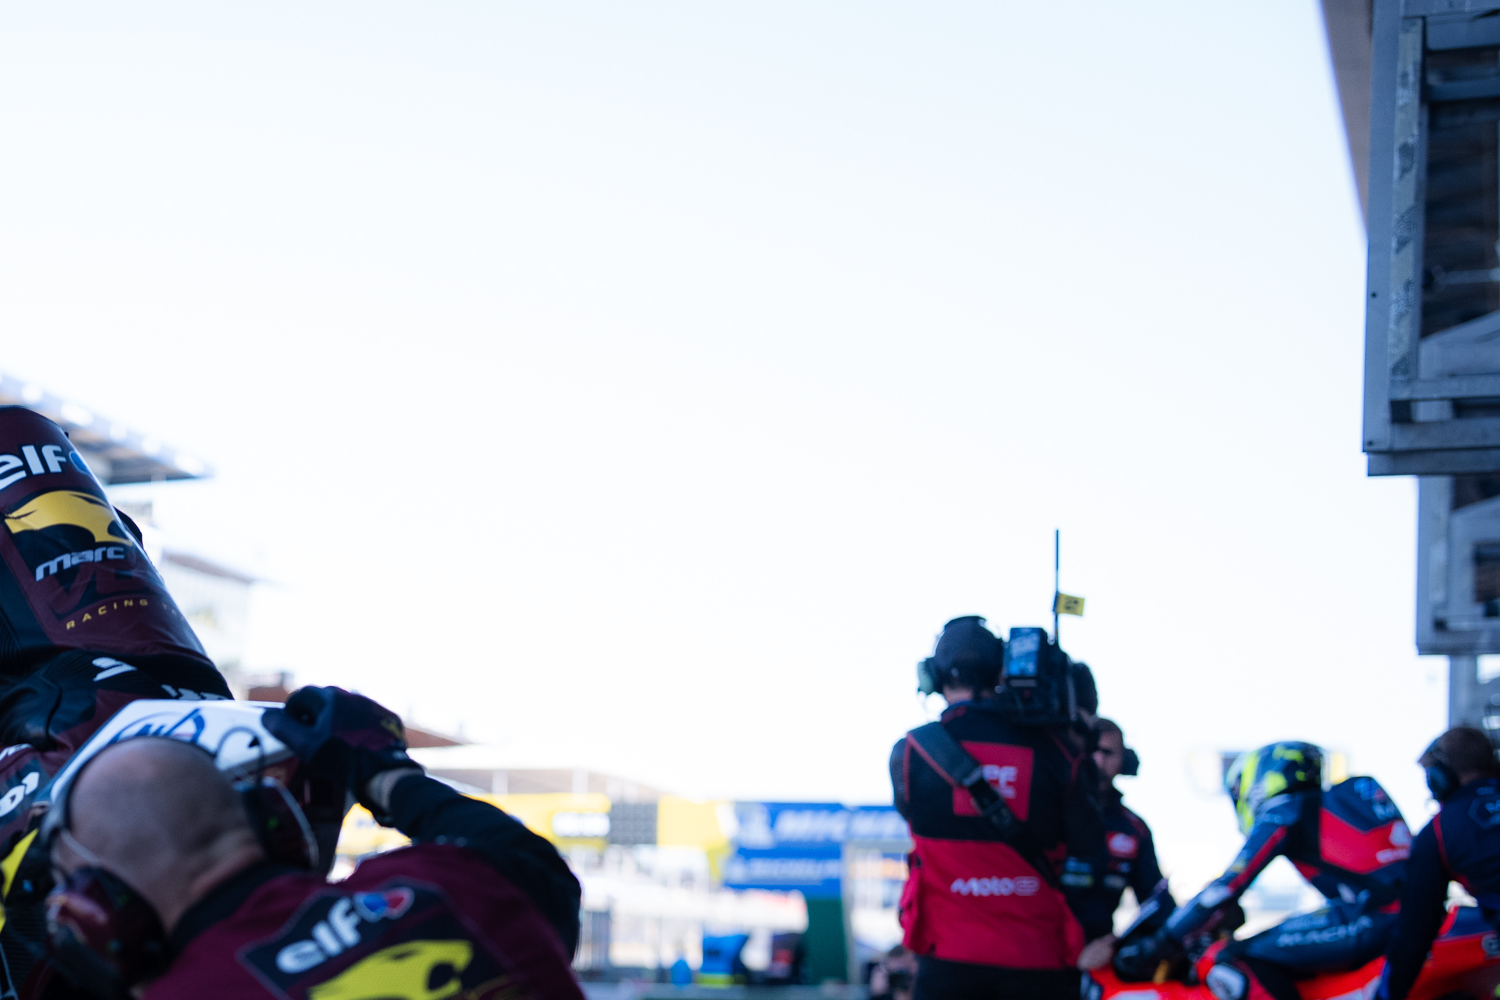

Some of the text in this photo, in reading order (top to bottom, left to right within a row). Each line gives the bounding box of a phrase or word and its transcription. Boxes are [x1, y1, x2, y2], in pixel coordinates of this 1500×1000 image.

[35, 545, 126, 583] marc
[66, 598, 149, 630] RACING
[276, 896, 362, 964] elf
